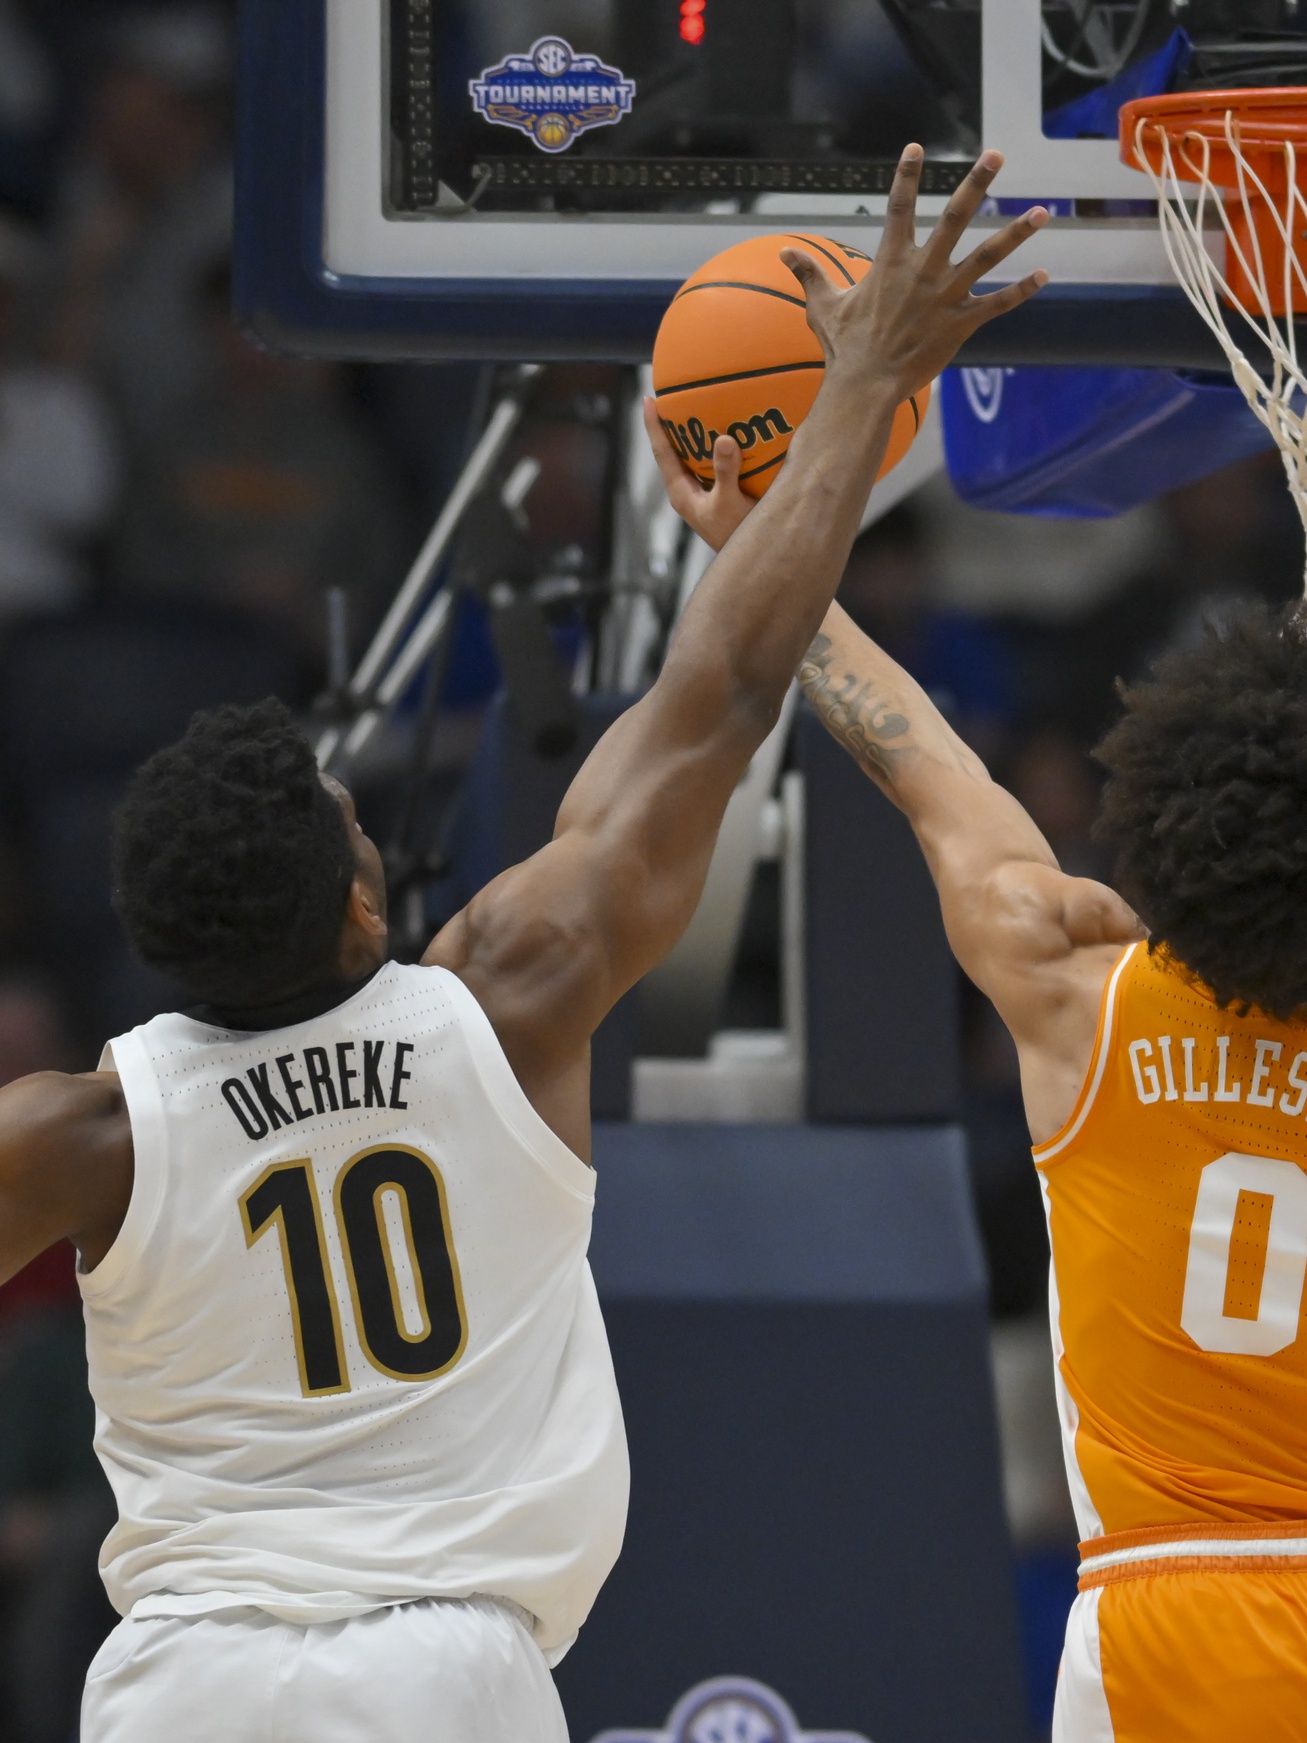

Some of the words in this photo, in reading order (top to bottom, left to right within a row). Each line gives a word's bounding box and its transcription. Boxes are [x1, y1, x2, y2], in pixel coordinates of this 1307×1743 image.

[538, 45, 566, 73] SEC
[475, 84, 630, 107] TOURNAMENT
[220, 1040, 414, 1141] OKEREKE
[237, 1142, 469, 1398] 10
